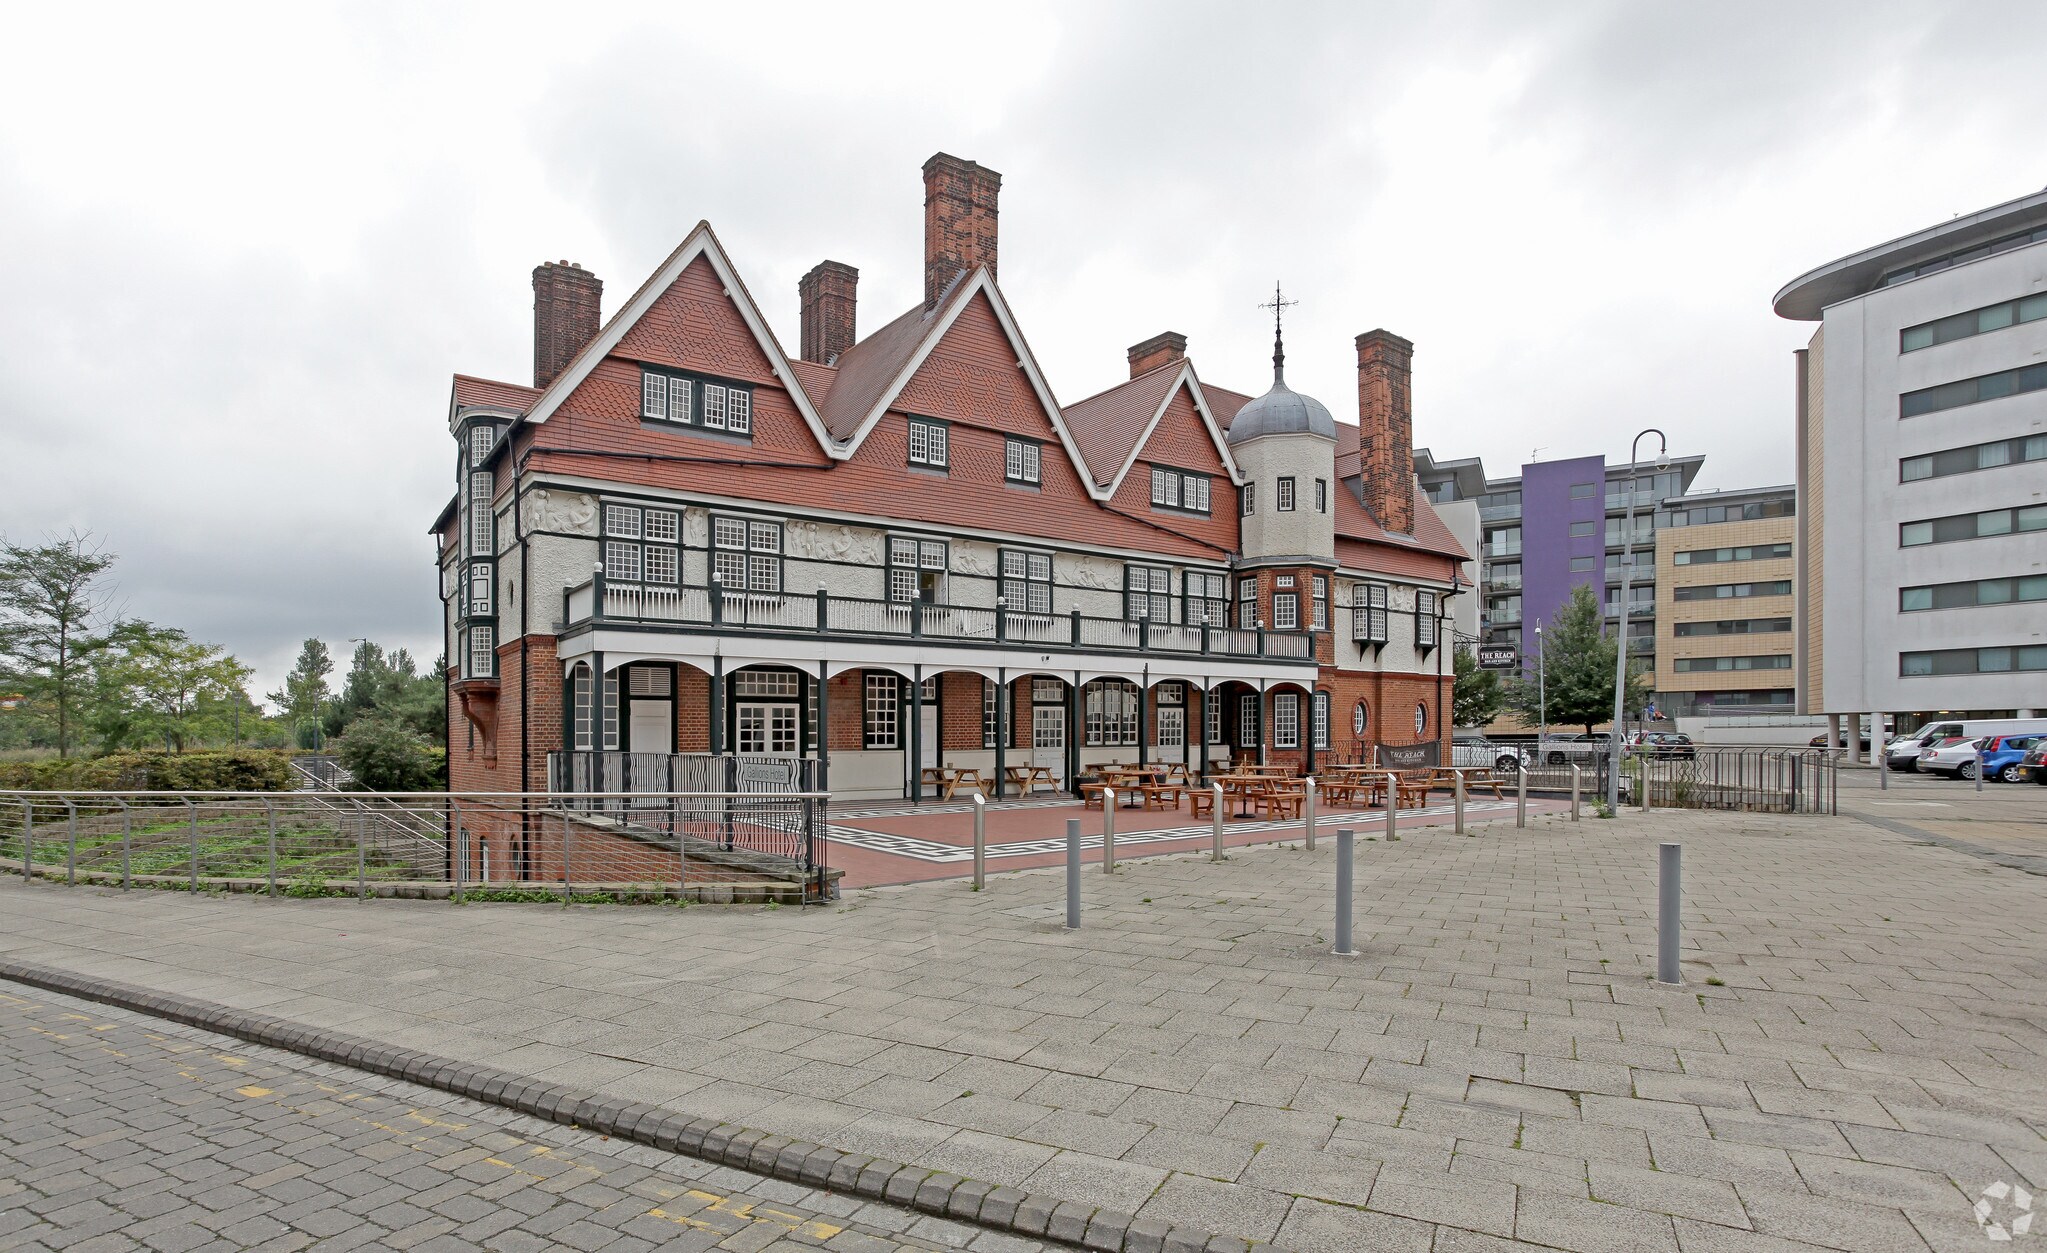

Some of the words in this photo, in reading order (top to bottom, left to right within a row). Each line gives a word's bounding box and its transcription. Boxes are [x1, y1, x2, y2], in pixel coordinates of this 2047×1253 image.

[1404, 750, 1425, 758] REACH
[747, 766, 769, 779] Gallions
[770, 768, 785, 781] Hotel
